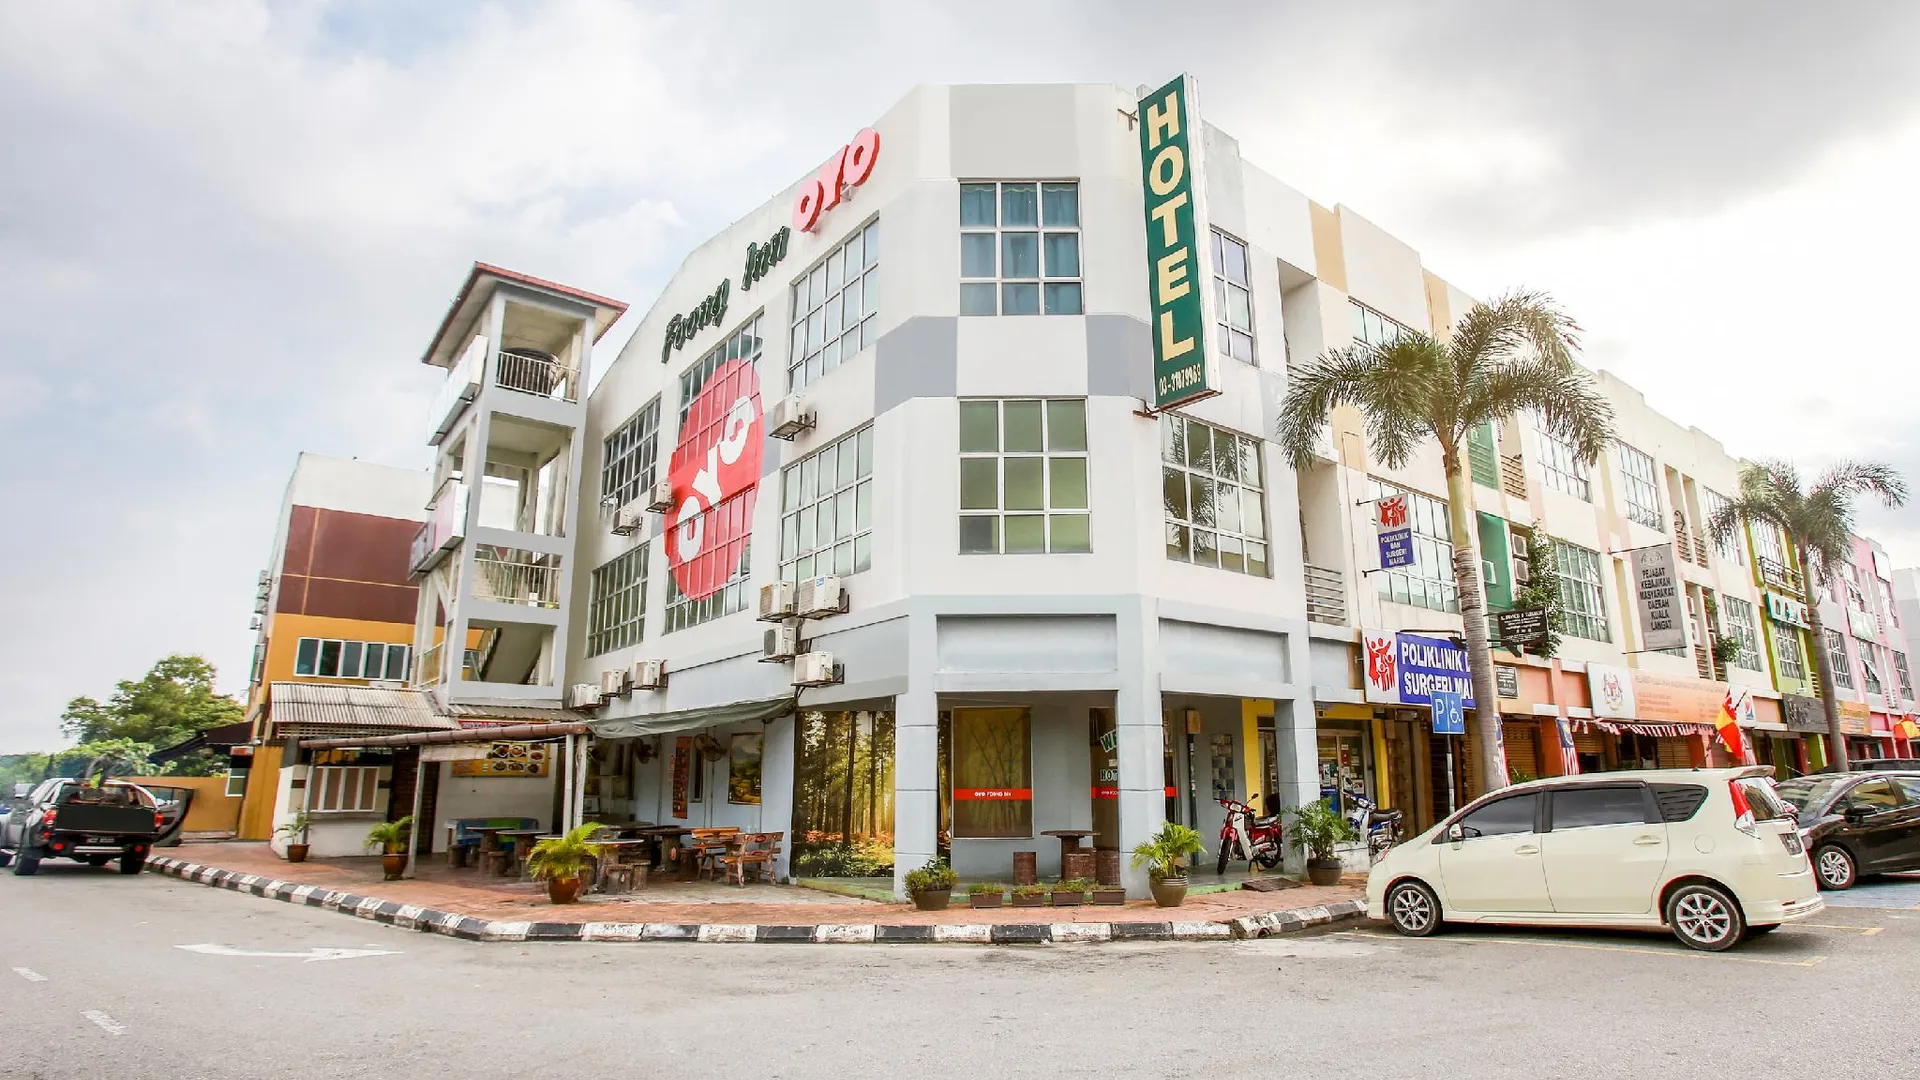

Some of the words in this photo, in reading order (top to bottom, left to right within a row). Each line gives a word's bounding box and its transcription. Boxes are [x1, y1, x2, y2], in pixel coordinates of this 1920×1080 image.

[740, 225, 791, 291] Inn
[792, 126, 880, 233] OYO
[1147, 90, 1195, 362] HOTEL
[676, 395, 755, 563] OYO
[1642, 567, 1666, 579] PEJABAT
[1641, 577, 1671, 589] KEBAJIKAN
[1640, 587, 1675, 600] MASYARAKAT
[1647, 599, 1670, 610] DAERAH
[1650, 608, 1670, 620] KUALA
[1650, 619, 1672, 631] LANGAT
[1401, 642, 1464, 673] POLIKLINIK
[1404, 671, 1452, 696] SURGERI
[1434, 698, 1445, 725] P
